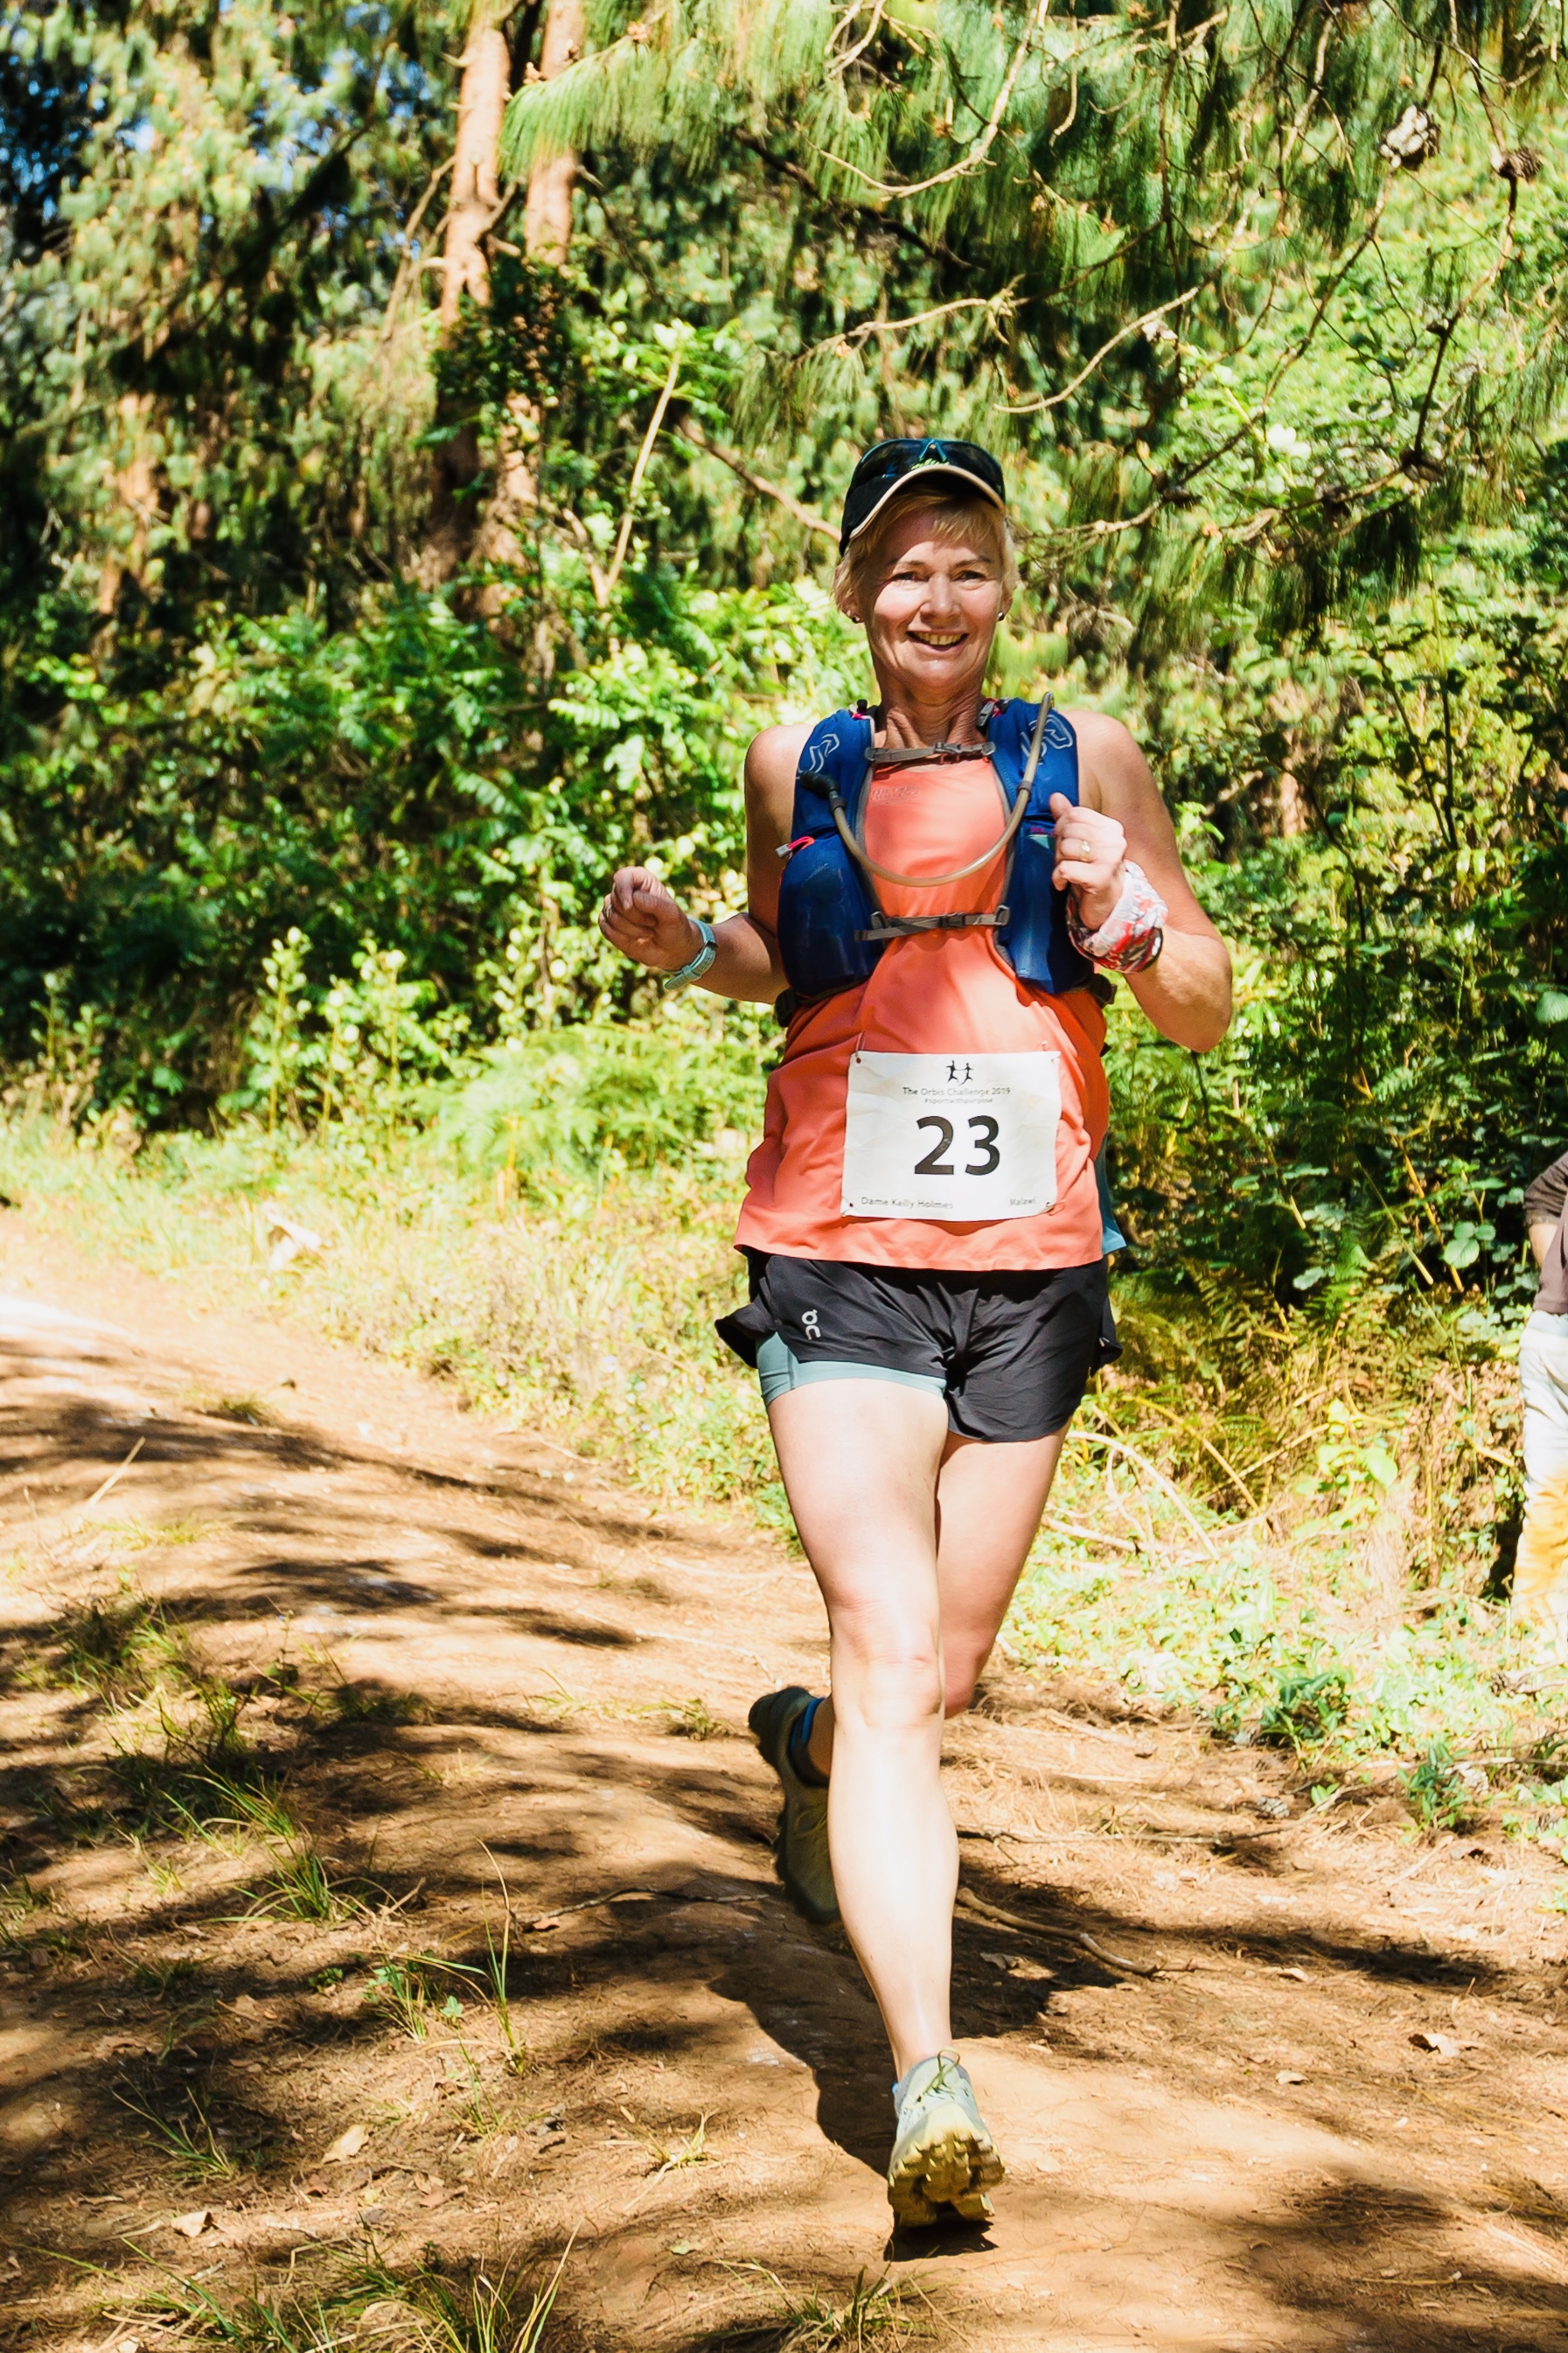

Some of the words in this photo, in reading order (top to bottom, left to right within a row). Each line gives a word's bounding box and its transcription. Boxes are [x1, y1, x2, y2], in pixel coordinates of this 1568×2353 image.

[902, 1086, 918, 1095] The
[920, 1087, 944, 1096] Orbis
[947, 1087, 989, 1098] Challenge
[991, 1086, 1011, 1095] 2019
[914, 1114, 1000, 1176] 23
[861, 1197, 889, 1206] Dame
[891, 1197, 916, 1209] Kelly
[917, 1199, 954, 1210] Holmes
